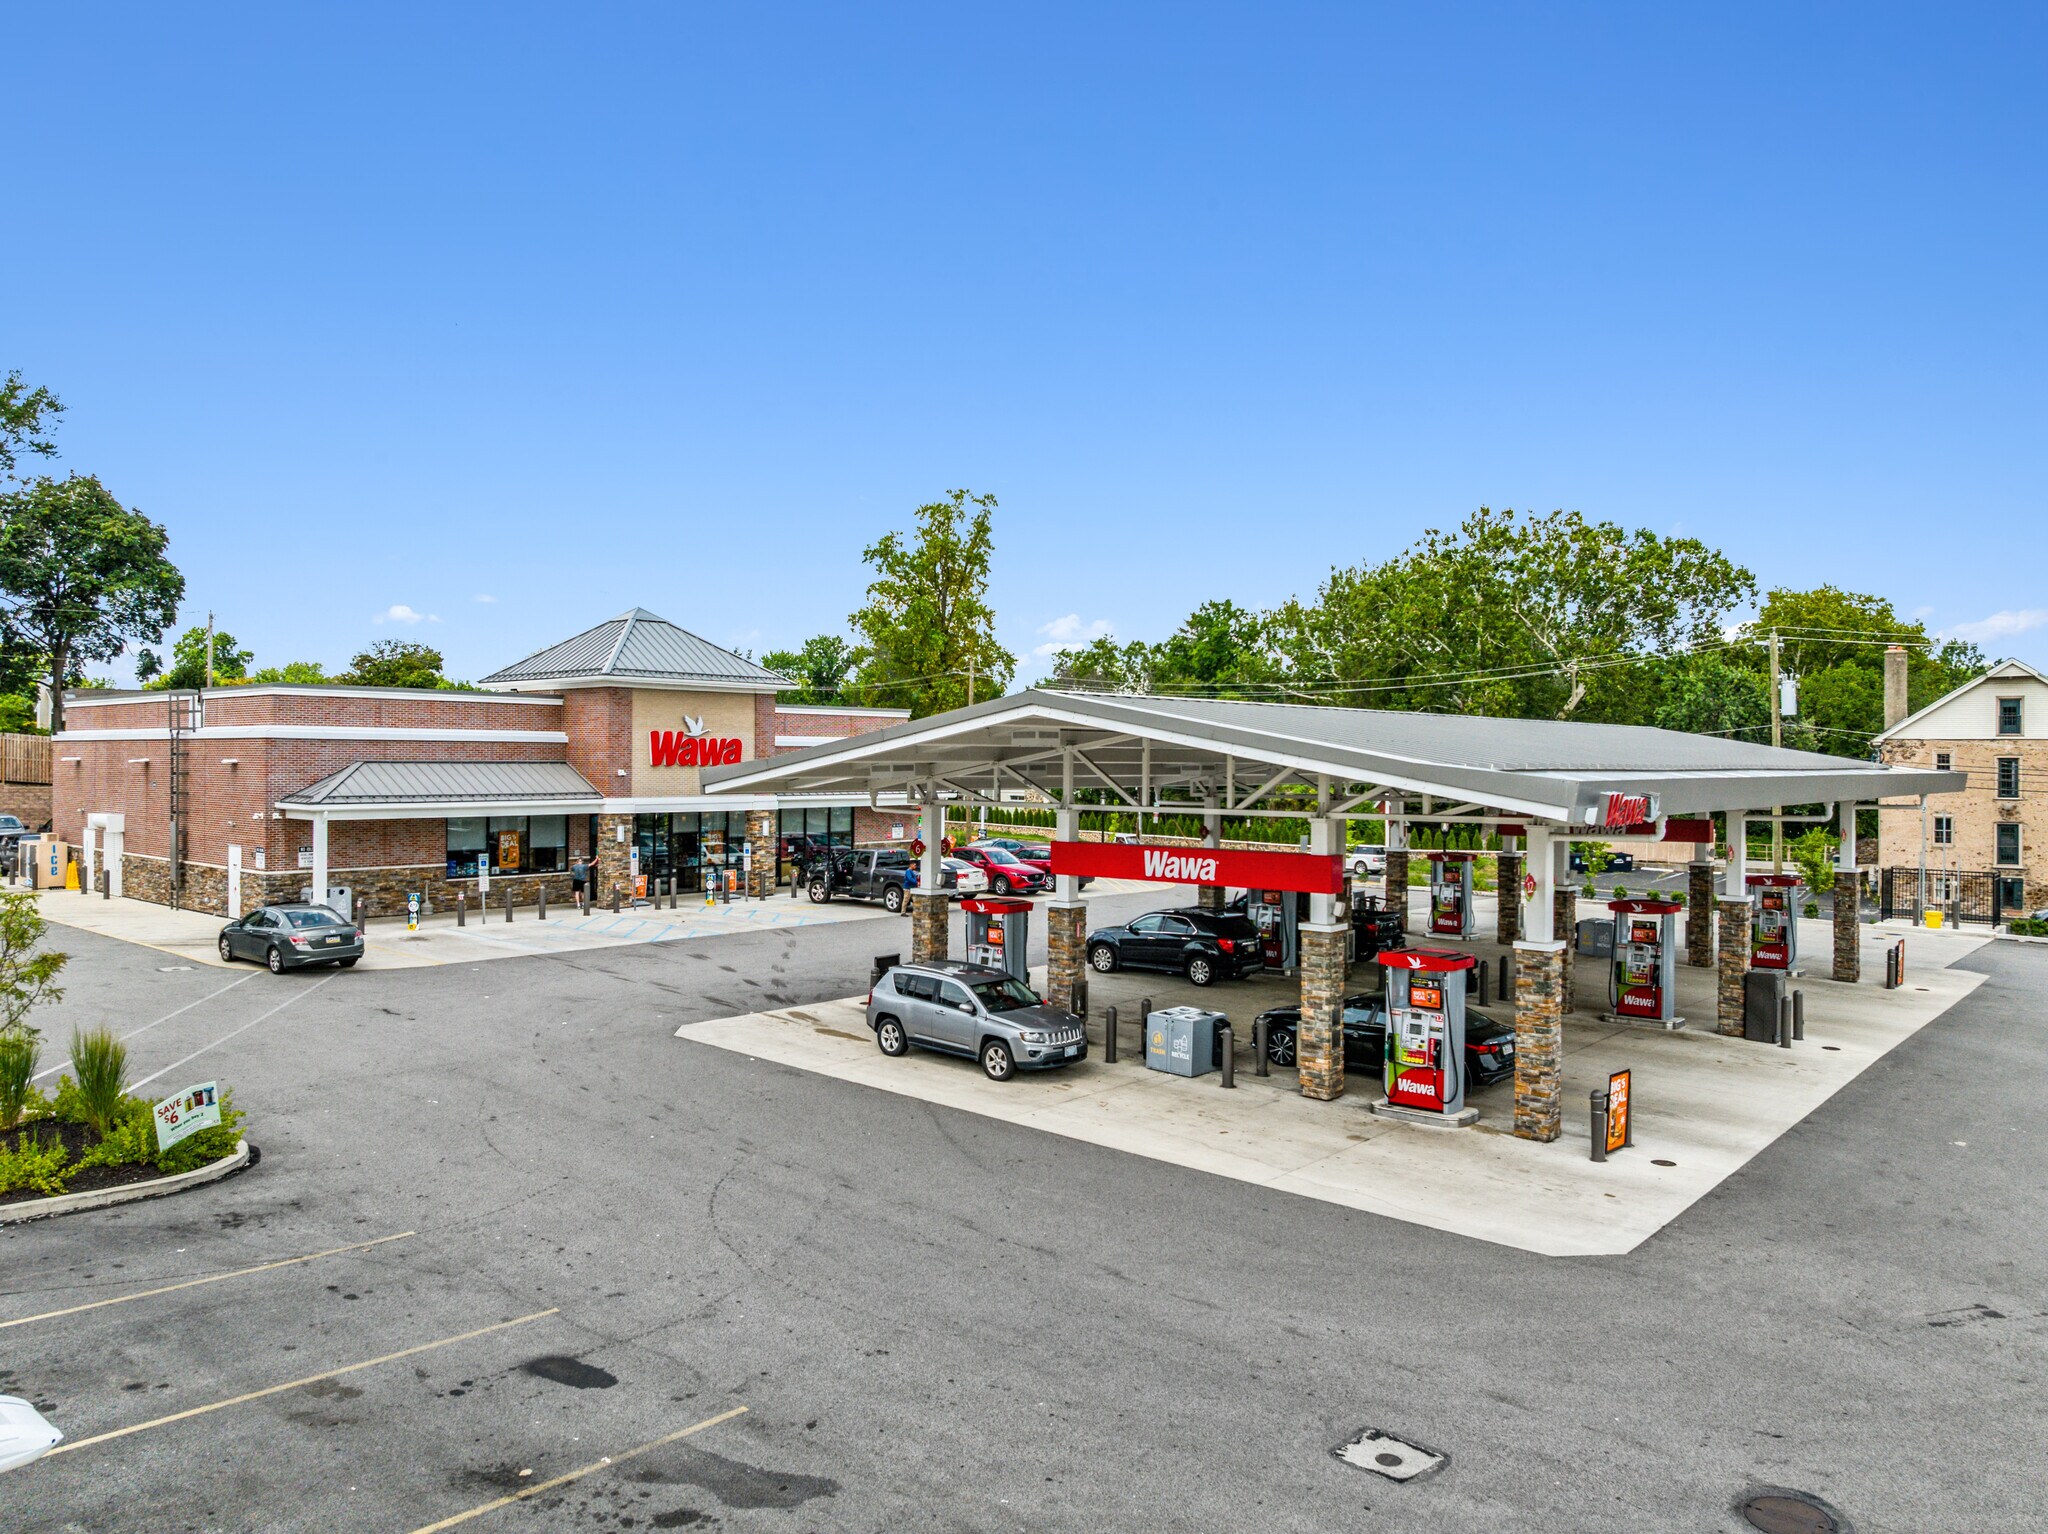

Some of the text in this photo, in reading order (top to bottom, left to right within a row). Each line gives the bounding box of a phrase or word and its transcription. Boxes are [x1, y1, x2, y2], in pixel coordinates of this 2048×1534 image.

[649, 730, 743, 767] Wawa
[1606, 793, 1647, 827] Wawa
[915, 844, 921, 854] 6
[941, 843, 947, 852] 5
[1144, 850, 1217, 881] Wawa
[1171, 1051, 1190, 1061] RECYCLE
[1397, 1077, 1436, 1097] Wawa
[157, 1098, 182, 1118] SAVE
[164, 1110, 179, 1124] $6
